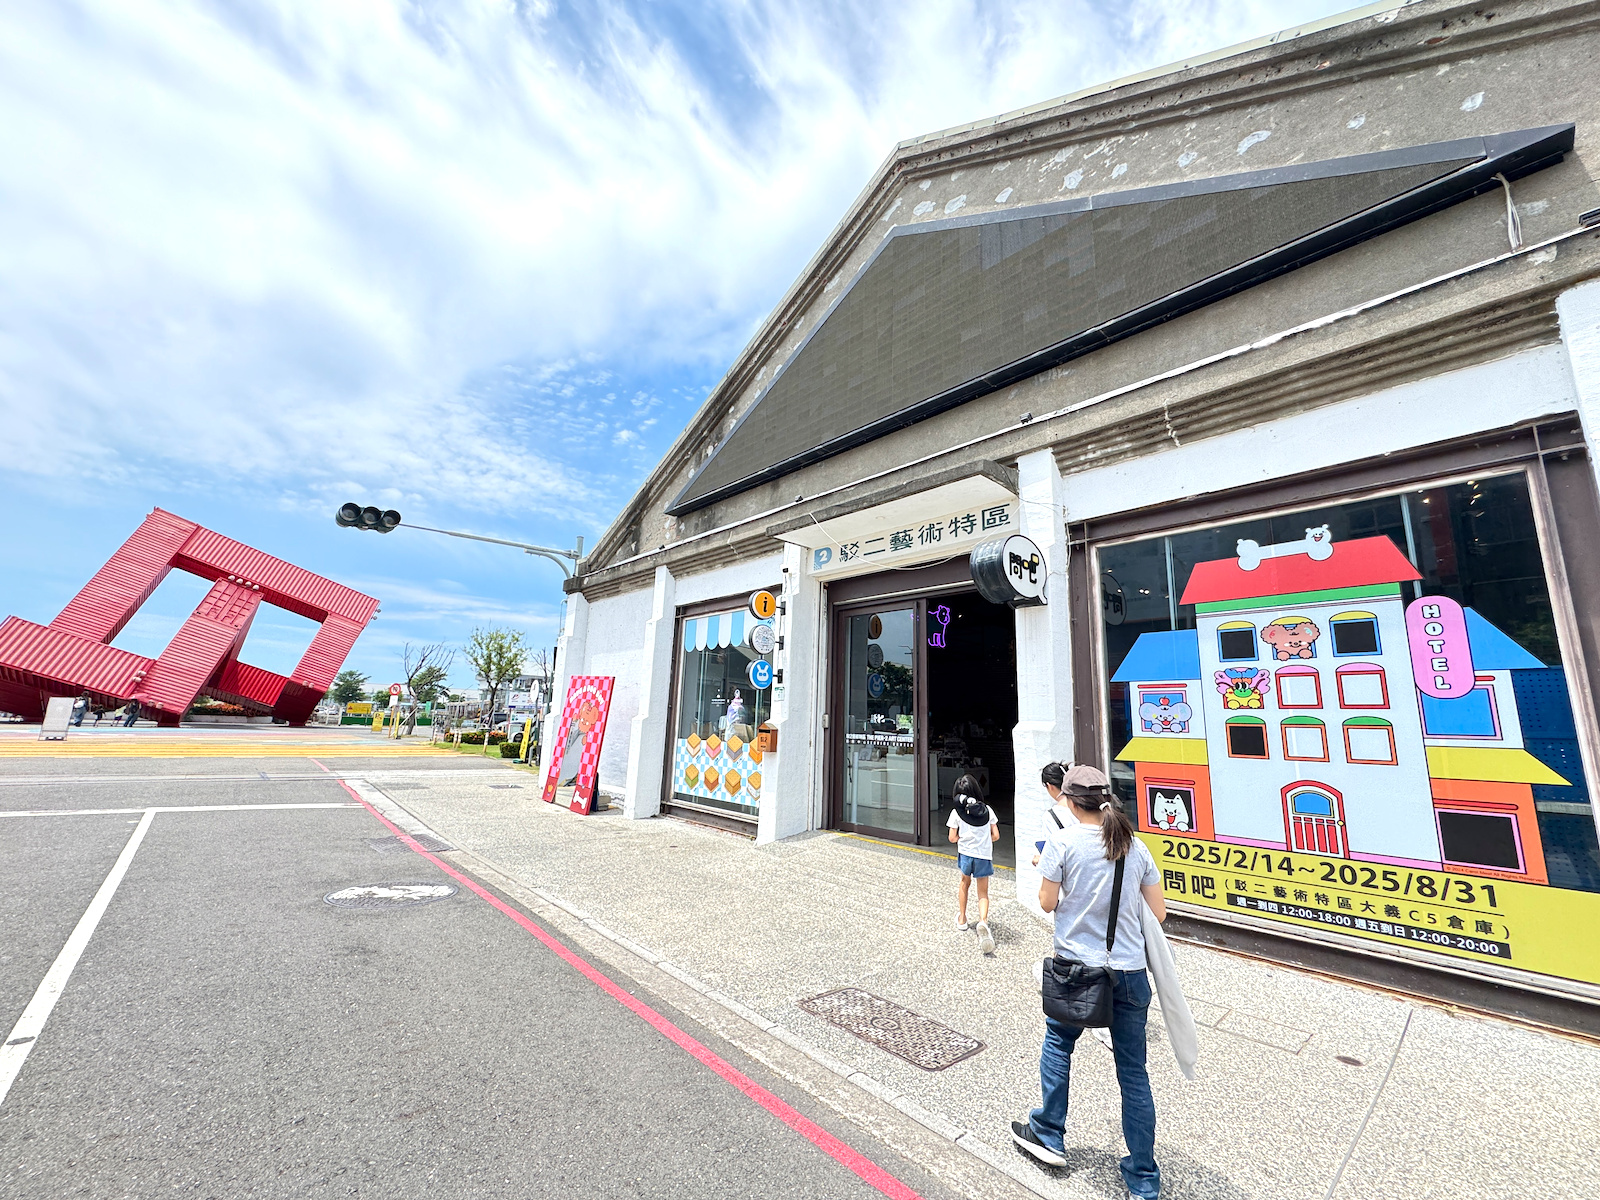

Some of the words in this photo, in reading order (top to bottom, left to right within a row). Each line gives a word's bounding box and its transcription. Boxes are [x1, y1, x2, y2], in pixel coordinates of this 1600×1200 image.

[839, 503, 1011, 563] 駁二藝術特區
[1008, 551, 1040, 584] 問吧
[762, 596, 768, 613] i
[1421, 603, 1452, 690] HOTEL
[1162, 839, 1498, 908] 2025/2/14~2025/8/31
[1163, 869, 1217, 900] 問吧
[1236, 896, 1279, 913] 週一到四
[1281, 906, 1351, 926] 12:00-18:00
[1354, 918, 1407, 938] 週五到日
[1410, 928, 1500, 955] 12:00-20:00
